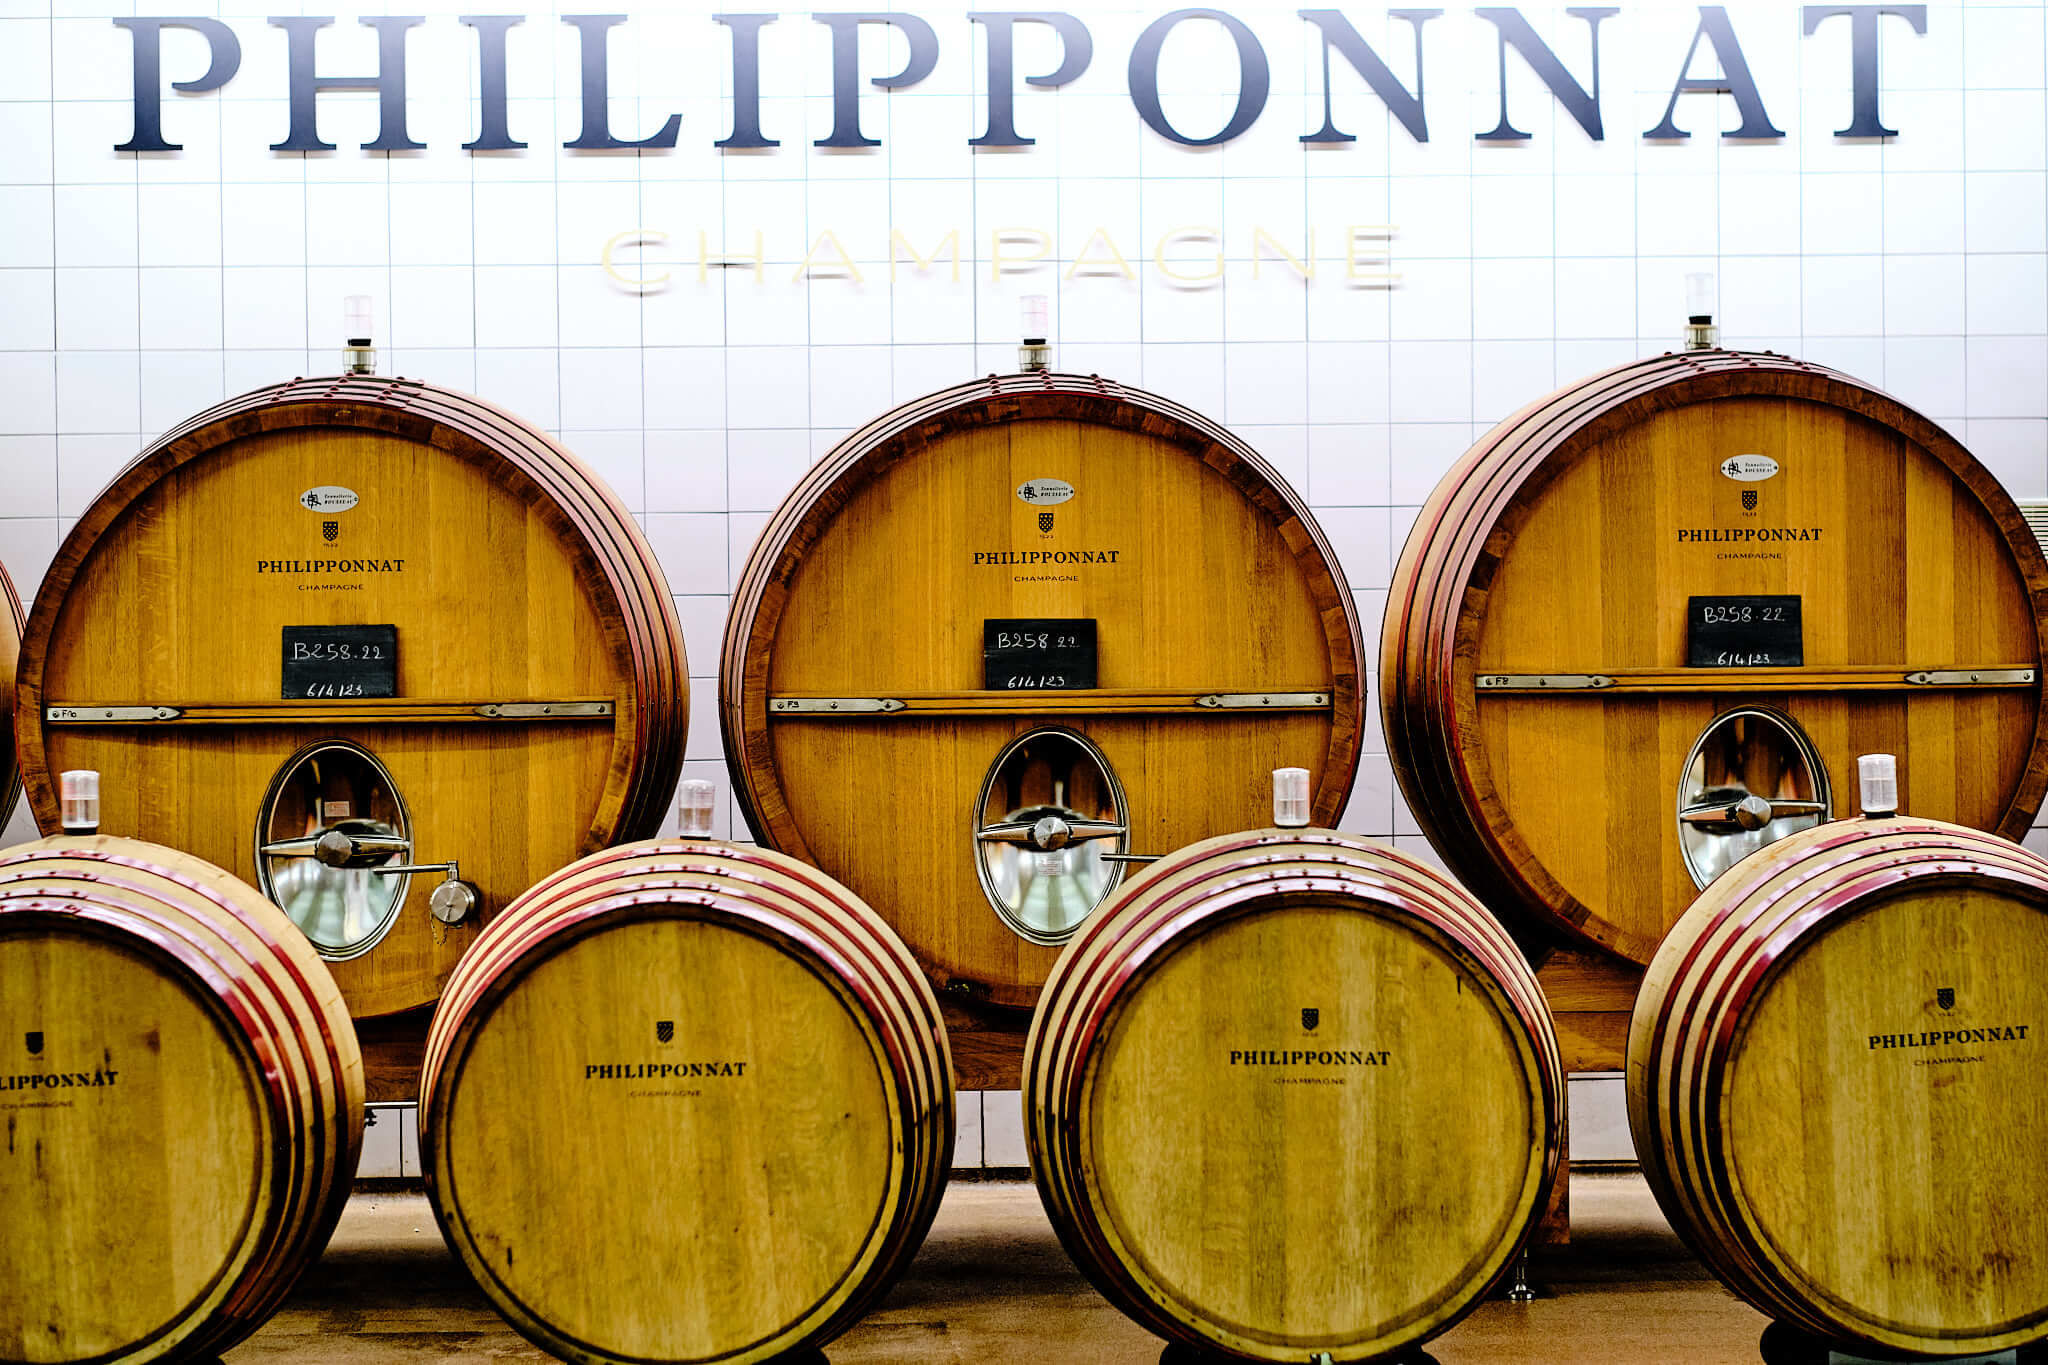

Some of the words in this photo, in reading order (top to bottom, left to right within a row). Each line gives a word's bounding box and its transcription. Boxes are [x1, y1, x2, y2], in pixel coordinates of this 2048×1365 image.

[113, 4, 1928, 152] PHILIPPONNAT
[601, 224, 1403, 291] CHAMPAGNE
[1678, 528, 1823, 543] PHILIPPONNAT
[974, 550, 1120, 565] PHILIPPONNAT
[1716, 552, 1782, 560] CHAMPAGNE
[257, 560, 405, 573] PHILIPPONNAT
[1717, 652, 1771, 666] 6/4/23
[1007, 675, 1065, 689] 6/4/23
[307, 683, 363, 697] 6/4/23
[1868, 1025, 2030, 1050] PHILIPPONNAT
[1230, 1050, 1392, 1066] PHILIPPONNAT
[585, 1062, 747, 1079] PHILIPPONNAT
